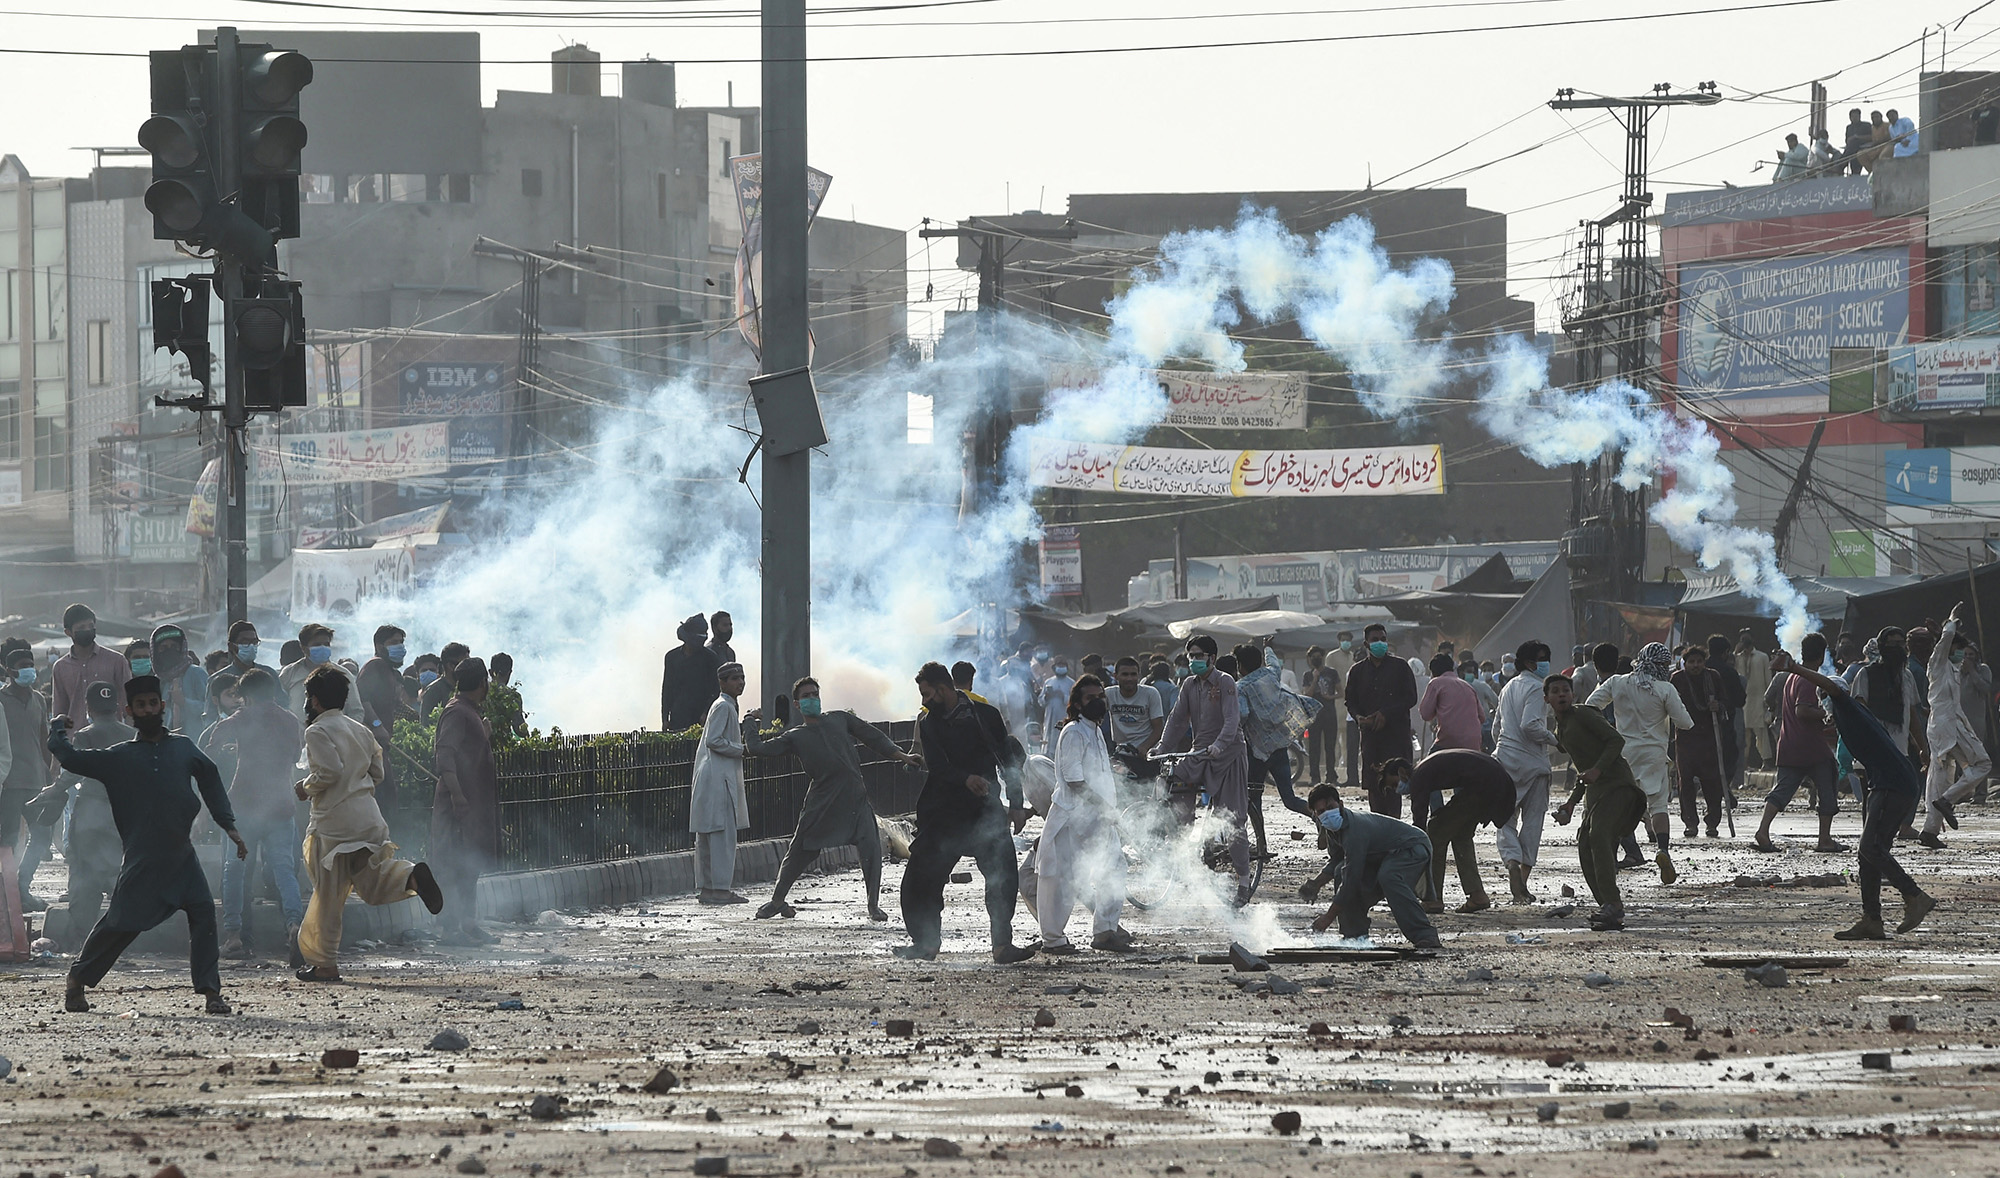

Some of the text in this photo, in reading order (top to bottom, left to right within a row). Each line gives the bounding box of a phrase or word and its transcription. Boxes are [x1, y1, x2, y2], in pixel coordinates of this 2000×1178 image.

[1742, 258, 1900, 301] UNIQUE SHAHDARA MOR CAMPUS
[1742, 307, 1782, 336] JUNIOR
[1795, 304, 1823, 330] HIGH
[1838, 301, 1884, 330] SCIENCE
[1739, 338, 1783, 367] SCHOOL
[1785, 334, 1829, 361] SCHOOL
[427, 367, 477, 386] IBM
[134, 519, 186, 544] SHUJA
[1046, 554, 1079, 566] Playgroup
[1359, 553, 1440, 572] UNIQUE SCIENCE ACADEMY
[1052, 574, 1075, 583] Matric
[1256, 565, 1319, 584] UNIQUE HIGH SCHOOL
[1282, 591, 1301, 605] Matric
